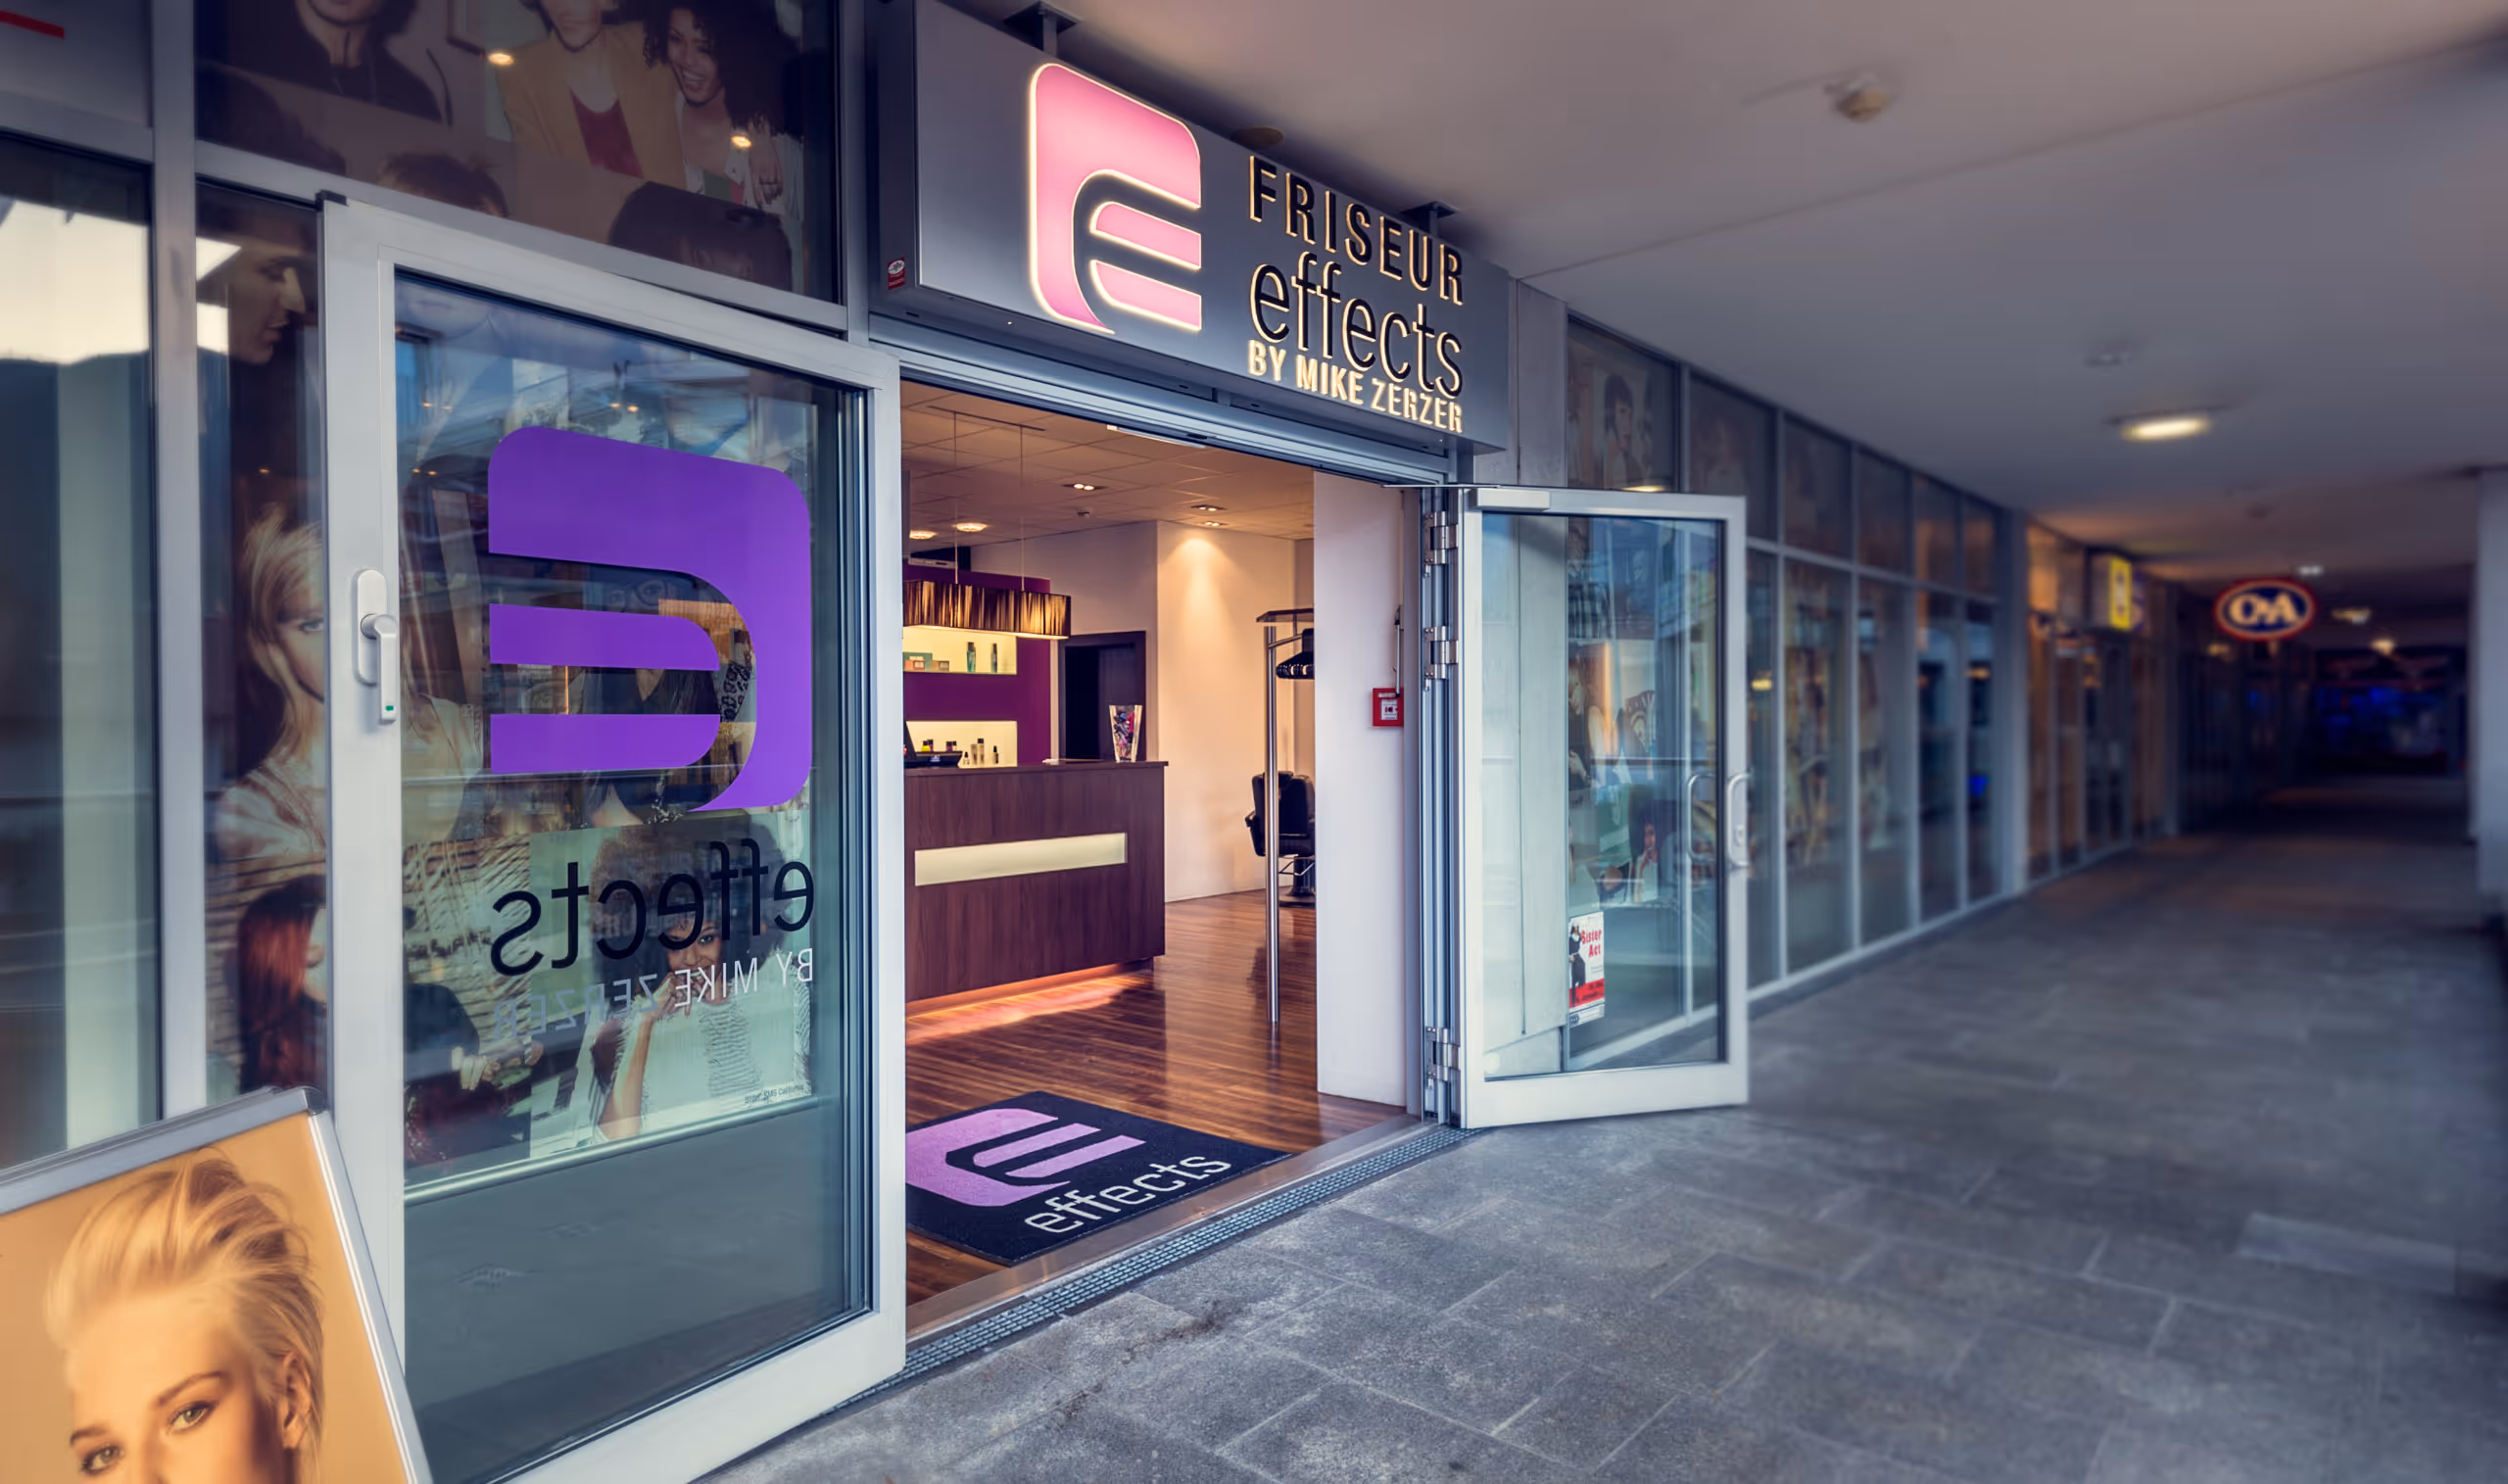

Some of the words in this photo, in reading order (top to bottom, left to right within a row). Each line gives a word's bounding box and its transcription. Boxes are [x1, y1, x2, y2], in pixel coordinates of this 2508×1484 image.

[1249, 154, 1464, 306] FRISEUR
[1250, 251, 1464, 398] effects
[1247, 339, 1285, 382] BY
[1295, 353, 1364, 406] MIKE
[1370, 377, 1464, 434] ZERZER
[1581, 930, 1602, 944] Sister
[1588, 944, 1601, 957] Act
[1024, 1155, 1232, 1234] effects
